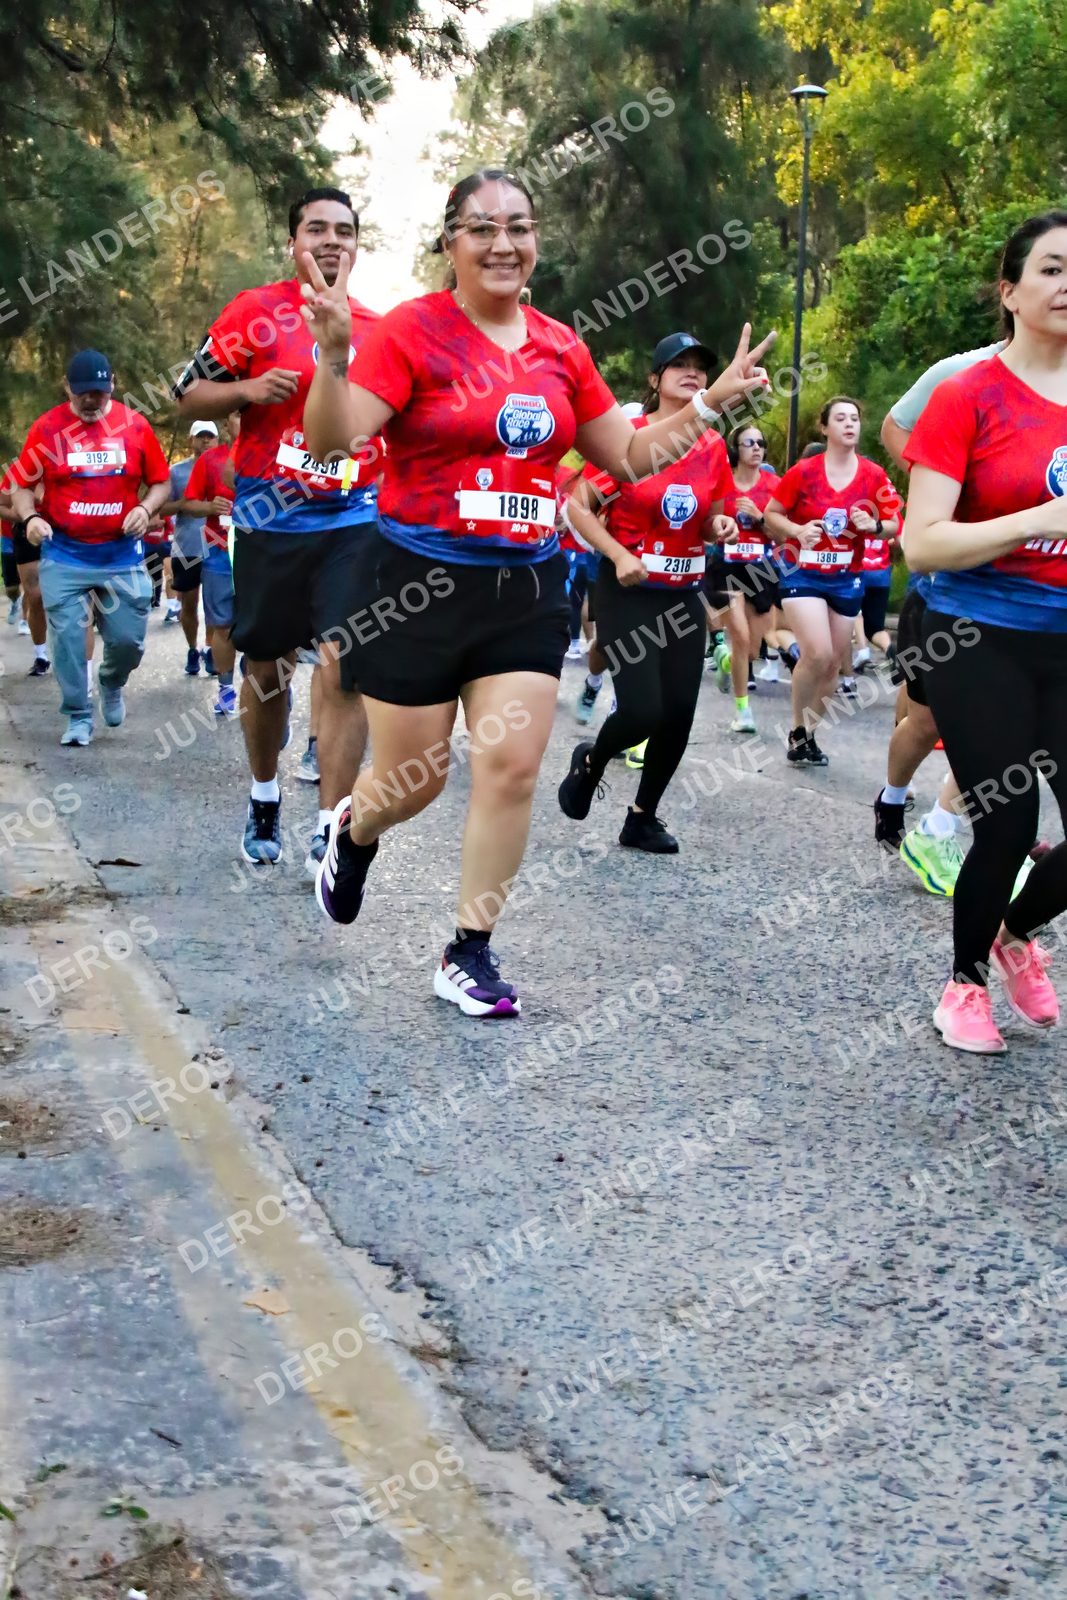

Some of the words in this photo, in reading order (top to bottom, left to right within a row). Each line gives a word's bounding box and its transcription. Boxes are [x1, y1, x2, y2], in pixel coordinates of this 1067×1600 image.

[512, 409, 542, 421] Global
[506, 417, 530, 429] Race
[86, 452, 109, 464] 3192
[69, 501, 123, 516] SANTIAGO
[499, 494, 539, 521] 1898
[664, 558, 692, 573] 2318
